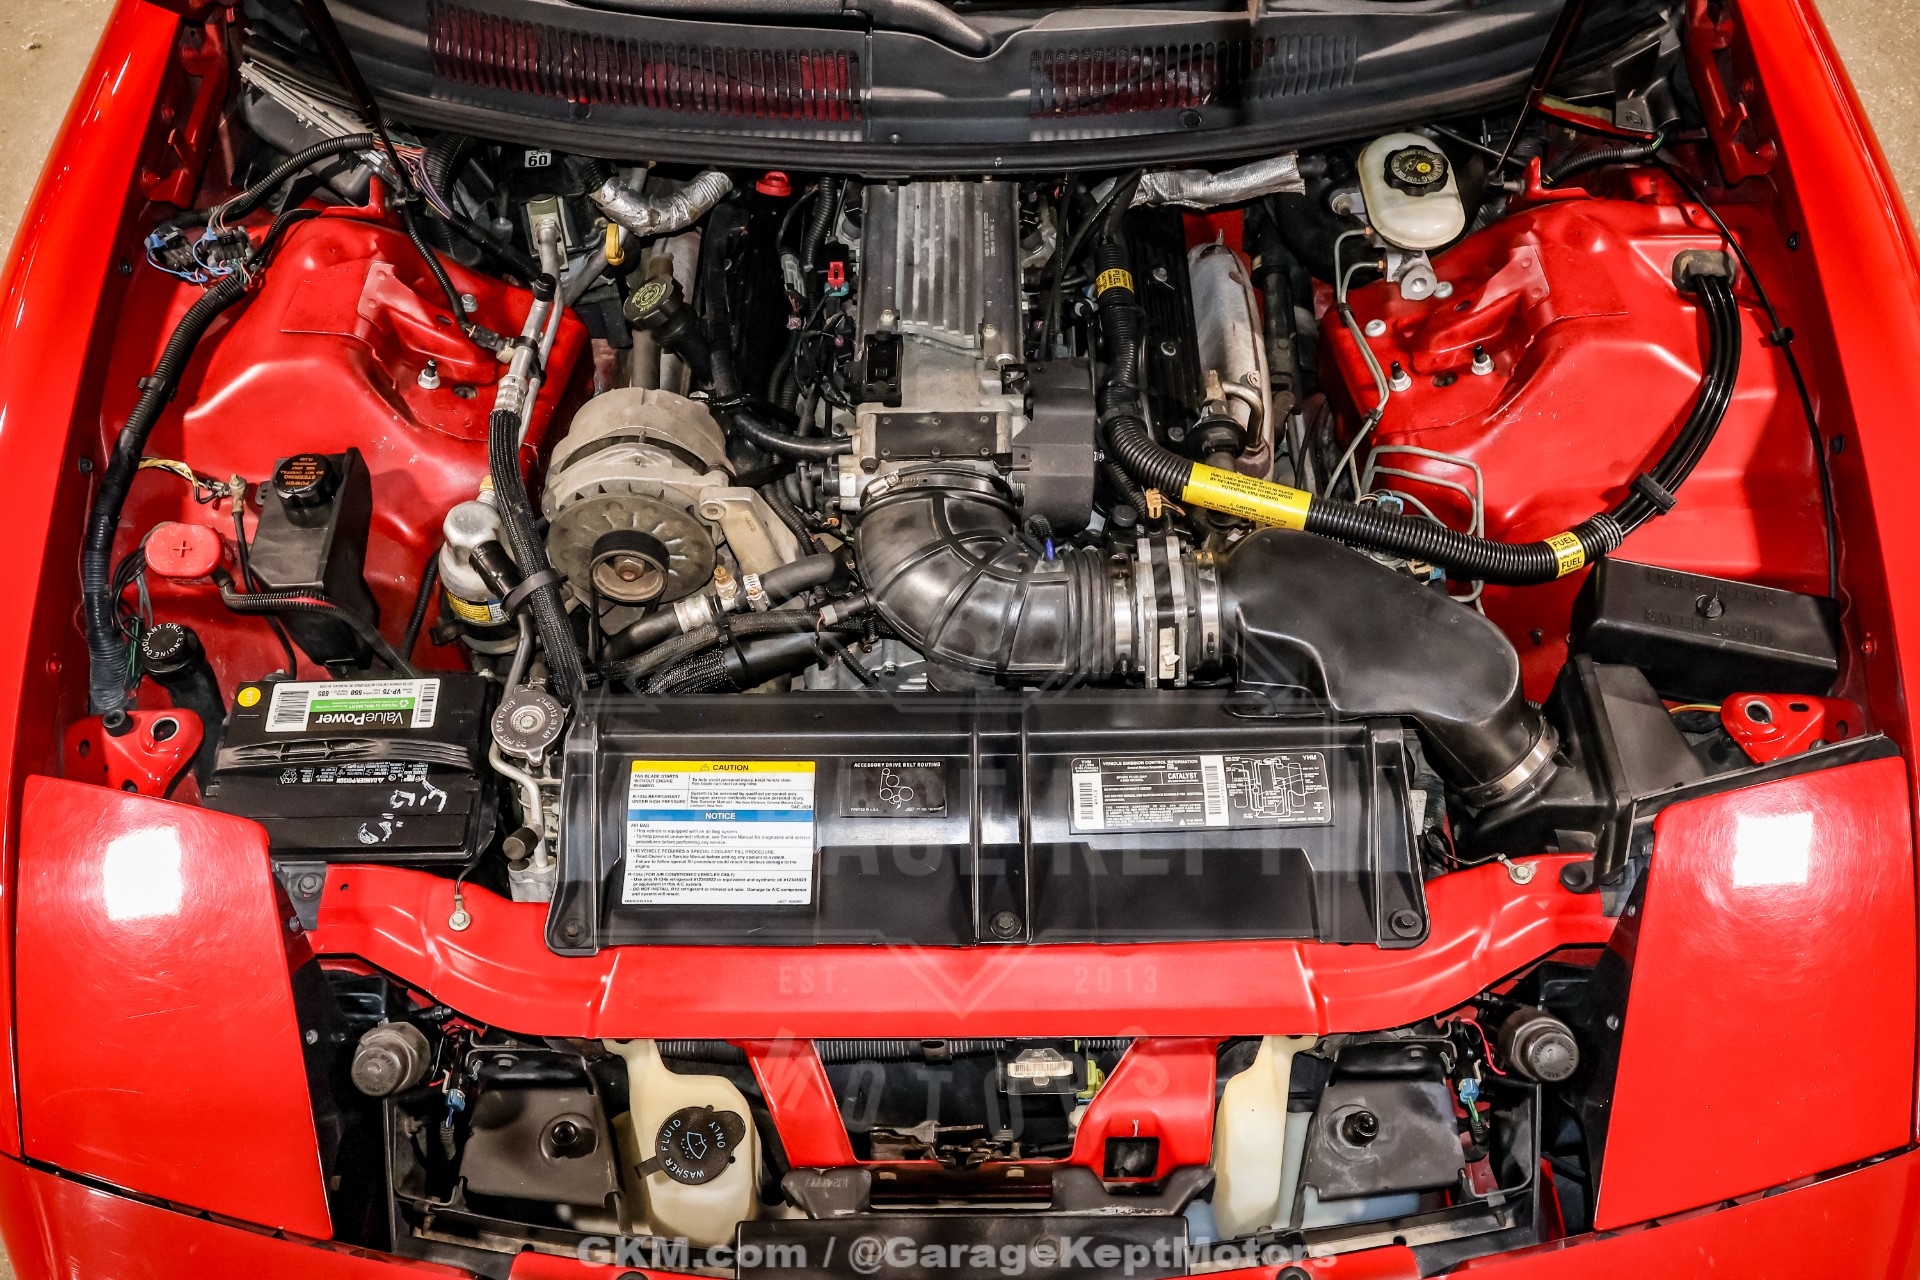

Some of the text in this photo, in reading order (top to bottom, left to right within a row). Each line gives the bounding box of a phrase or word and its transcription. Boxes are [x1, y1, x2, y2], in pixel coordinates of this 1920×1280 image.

[529, 155, 547, 166] 60
[1422, 158, 1441, 182] WARNING
[1235, 504, 1257, 513] CAUTION
[1553, 537, 1575, 548] FUEL
[1562, 557, 1582, 569] FUEL
[142, 623, 183, 658] ENGINE COOLANT ONLY
[315, 711, 403, 725] ValuePower
[661, 1120, 725, 1179] WASHER FLUID ONLY
